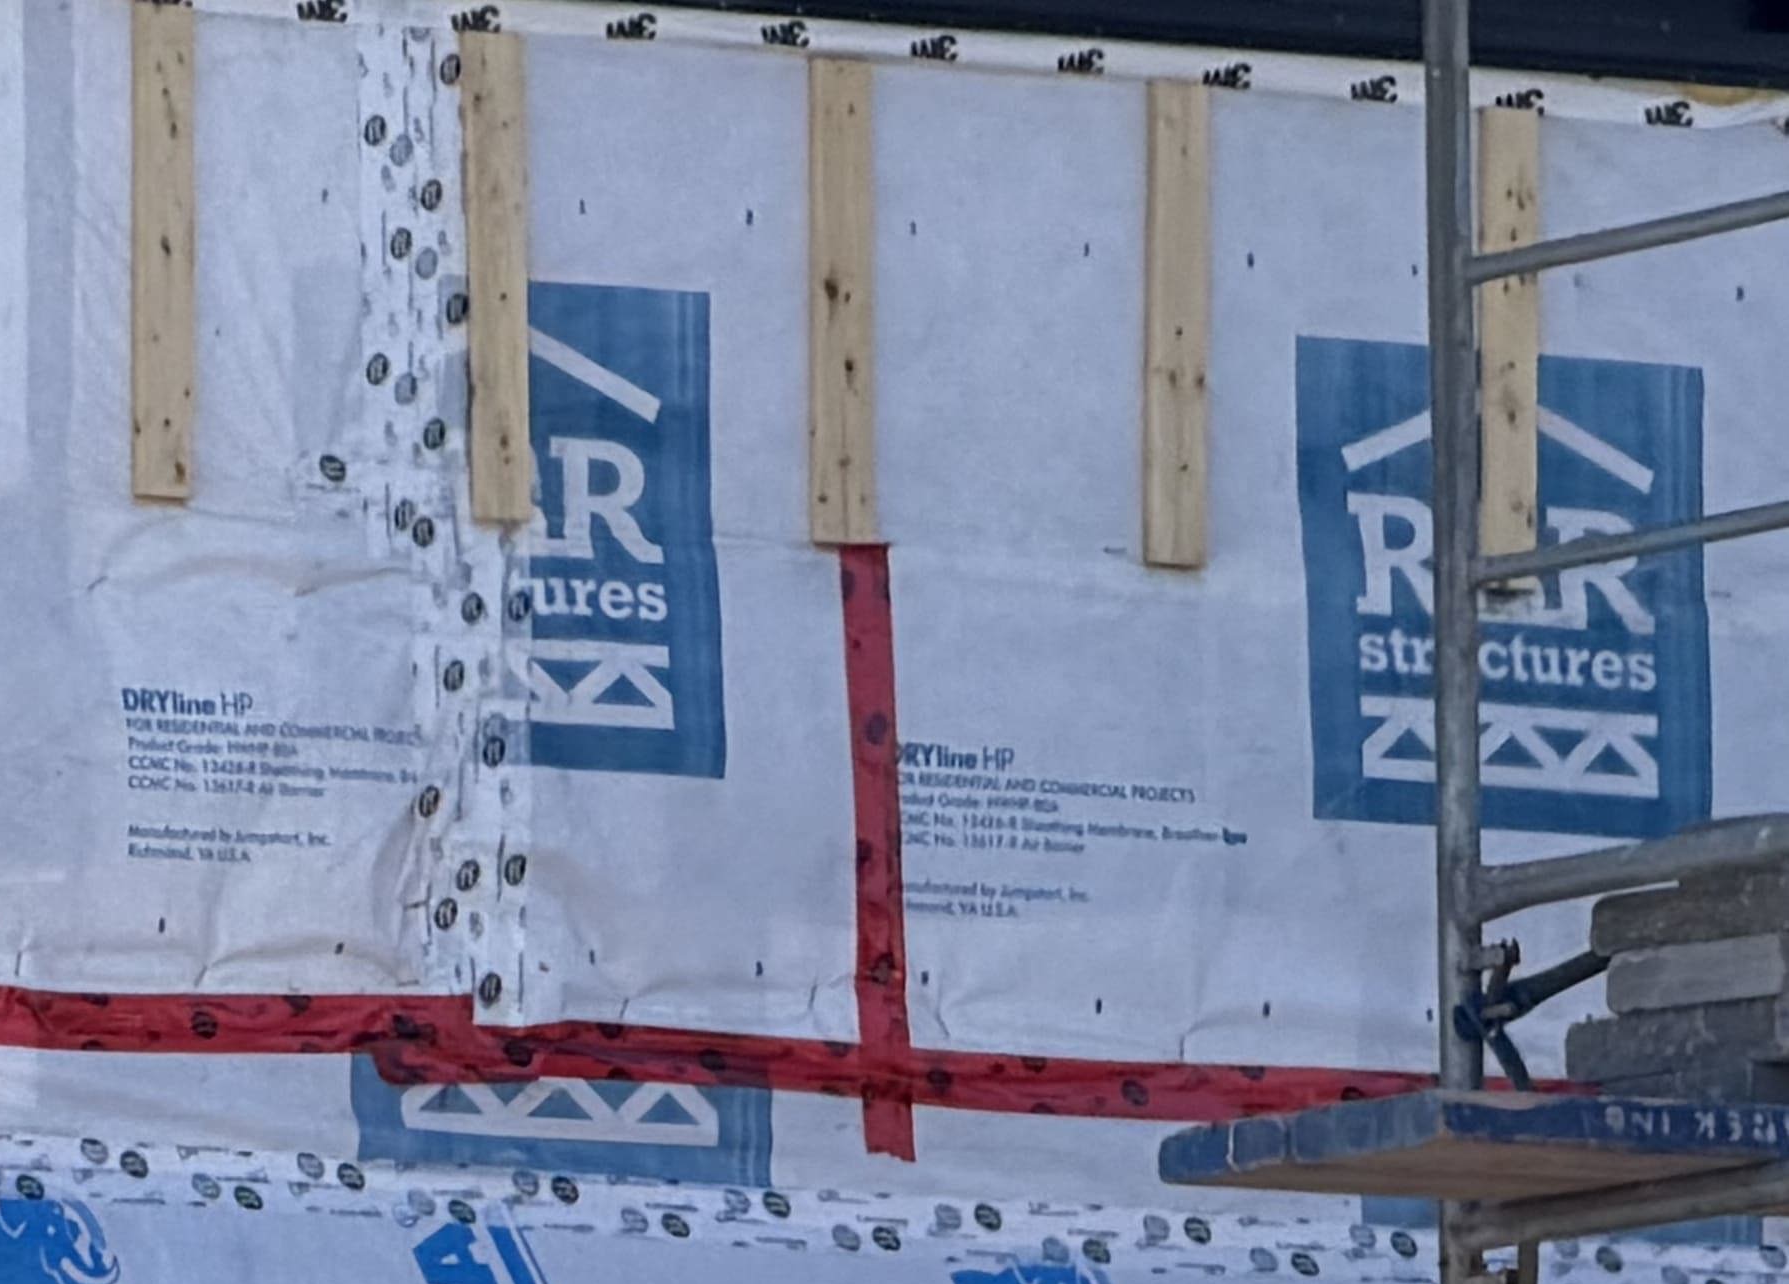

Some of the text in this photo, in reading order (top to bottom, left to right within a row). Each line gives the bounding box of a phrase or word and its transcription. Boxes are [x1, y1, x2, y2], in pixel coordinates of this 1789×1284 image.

[1346, 492, 1655, 635] RR
[1360, 629, 1657, 691] strctures
[122, 688, 254, 716] DRYline HP
[902, 742, 1015, 771] RYline HP
